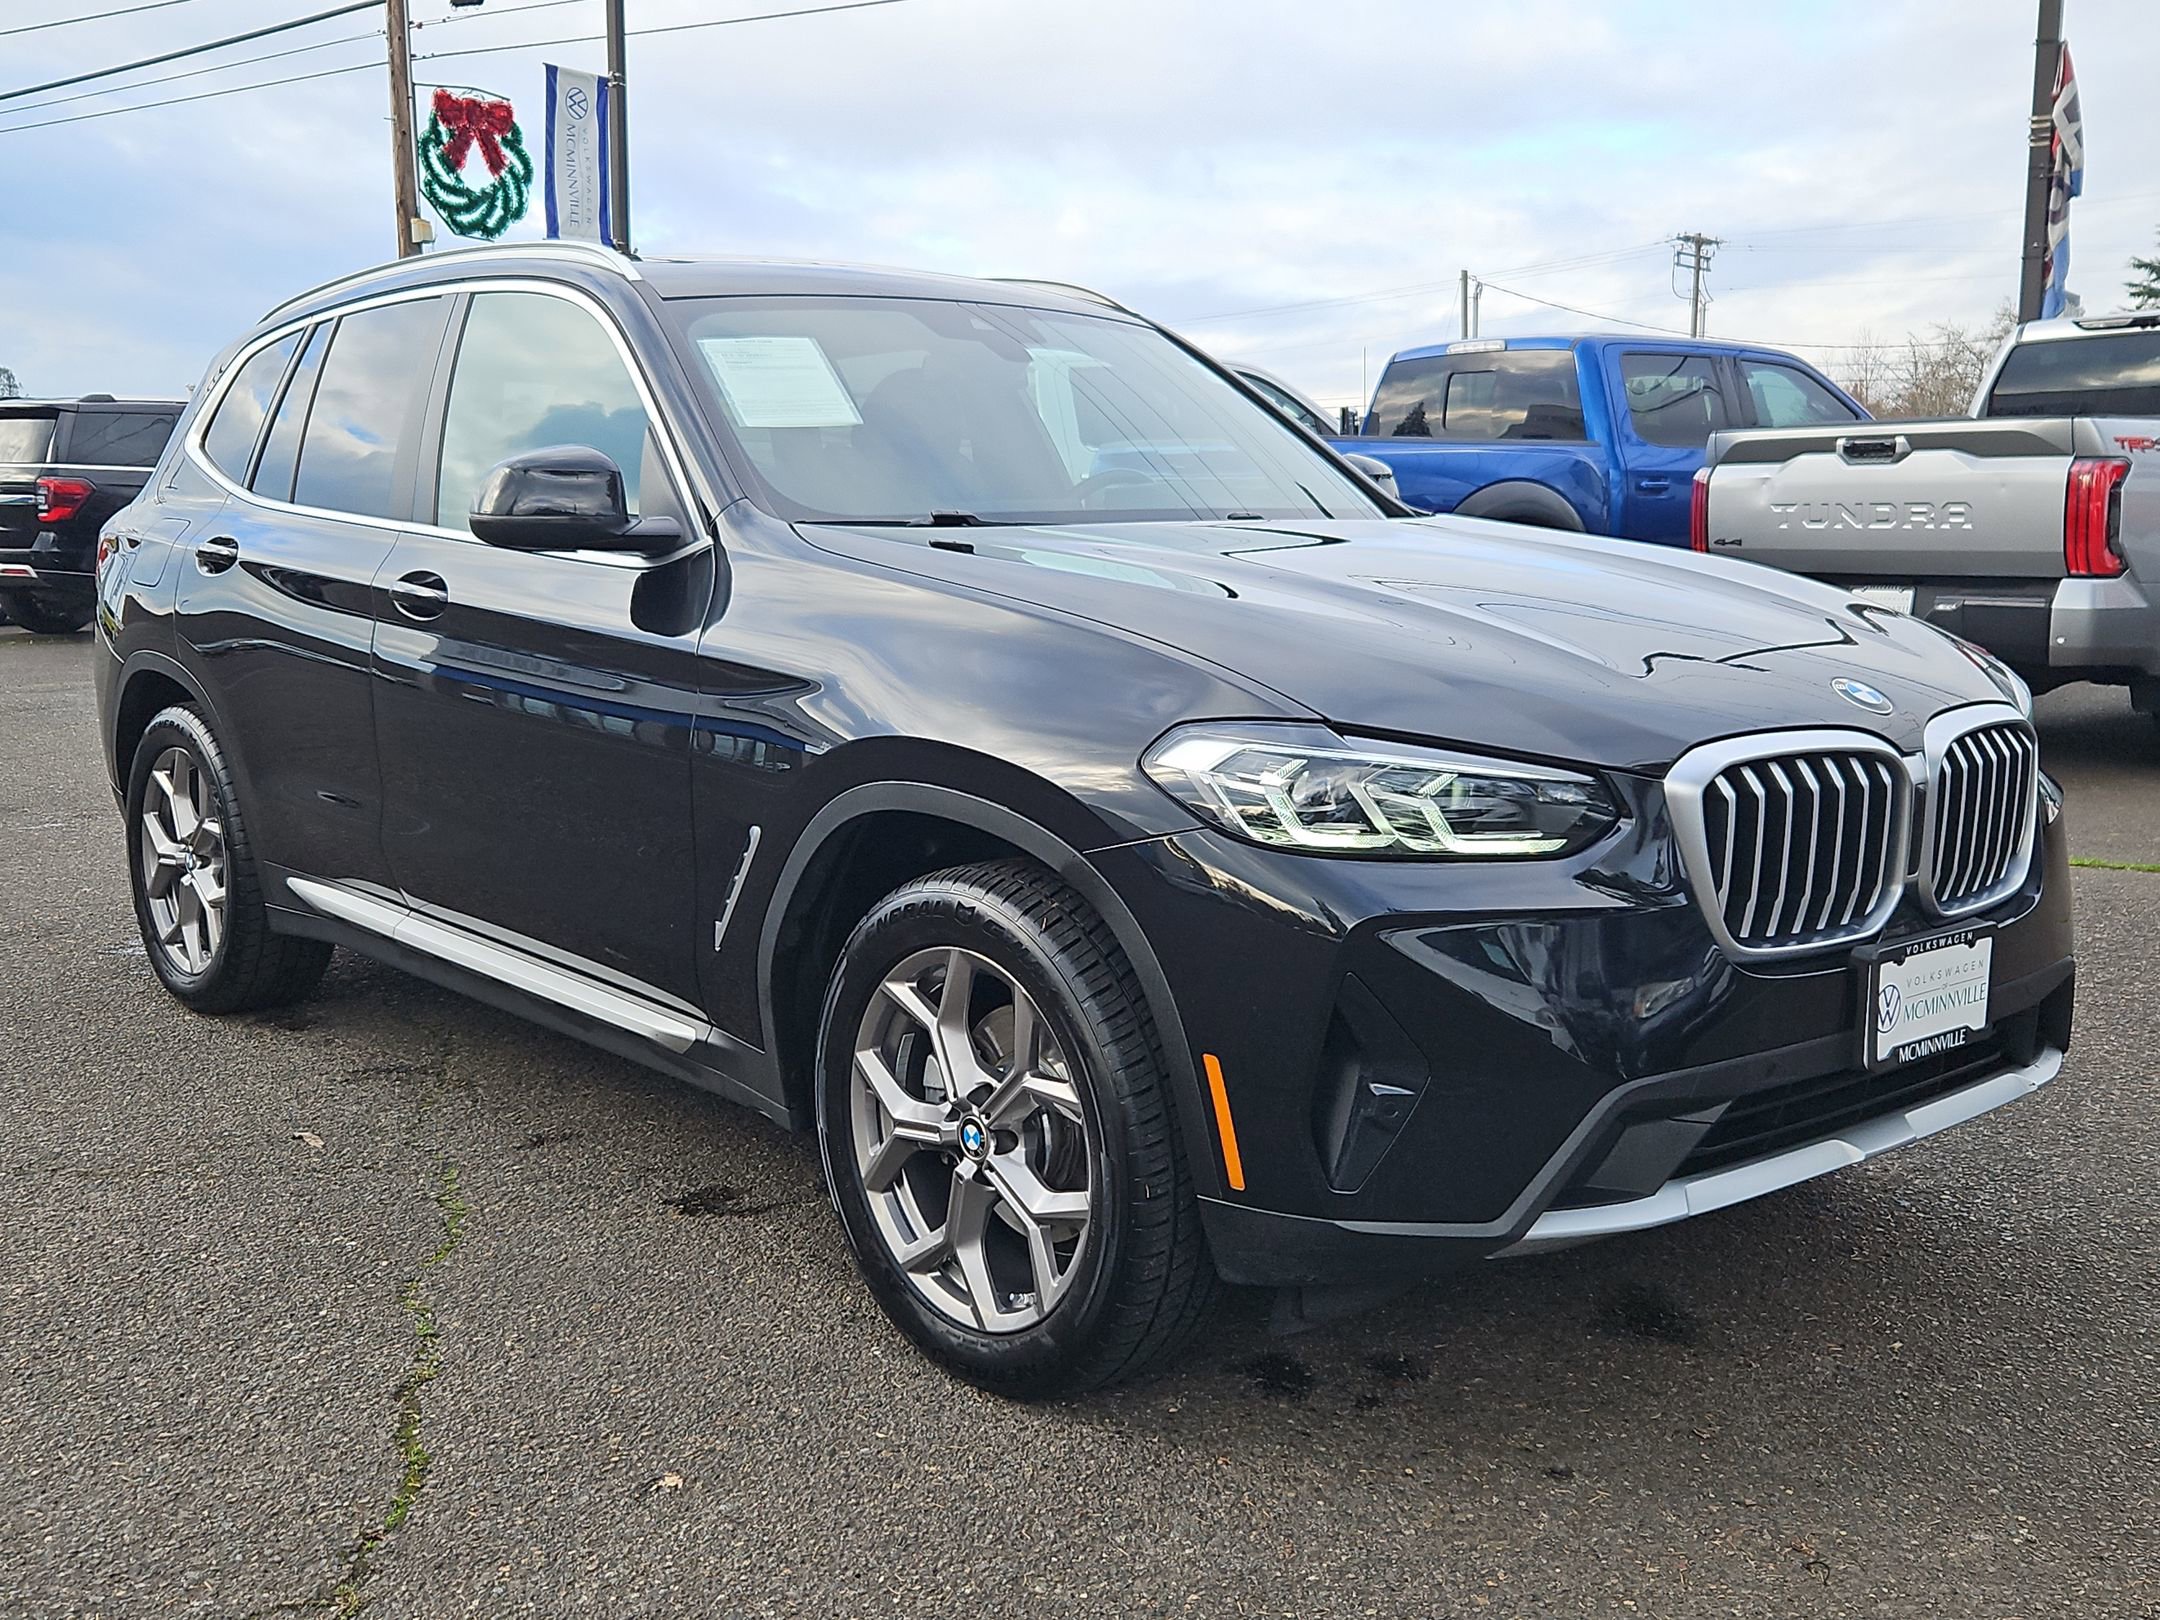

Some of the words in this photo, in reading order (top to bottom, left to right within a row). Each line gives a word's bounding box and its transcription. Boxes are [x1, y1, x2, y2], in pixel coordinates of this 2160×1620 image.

[565, 123, 579, 227] MCMINNVILLE
[1771, 501, 1973, 530] TUNDRA
[856, 899, 944, 940] ENERAL
[1906, 931, 1973, 956] VOLKSWAGEN
[1906, 959, 1985, 988] VOLKSWAGEN
[1904, 983, 1986, 1022] MCMINNVILLE
[1899, 1028, 1967, 1064] MCMINNVILLE
